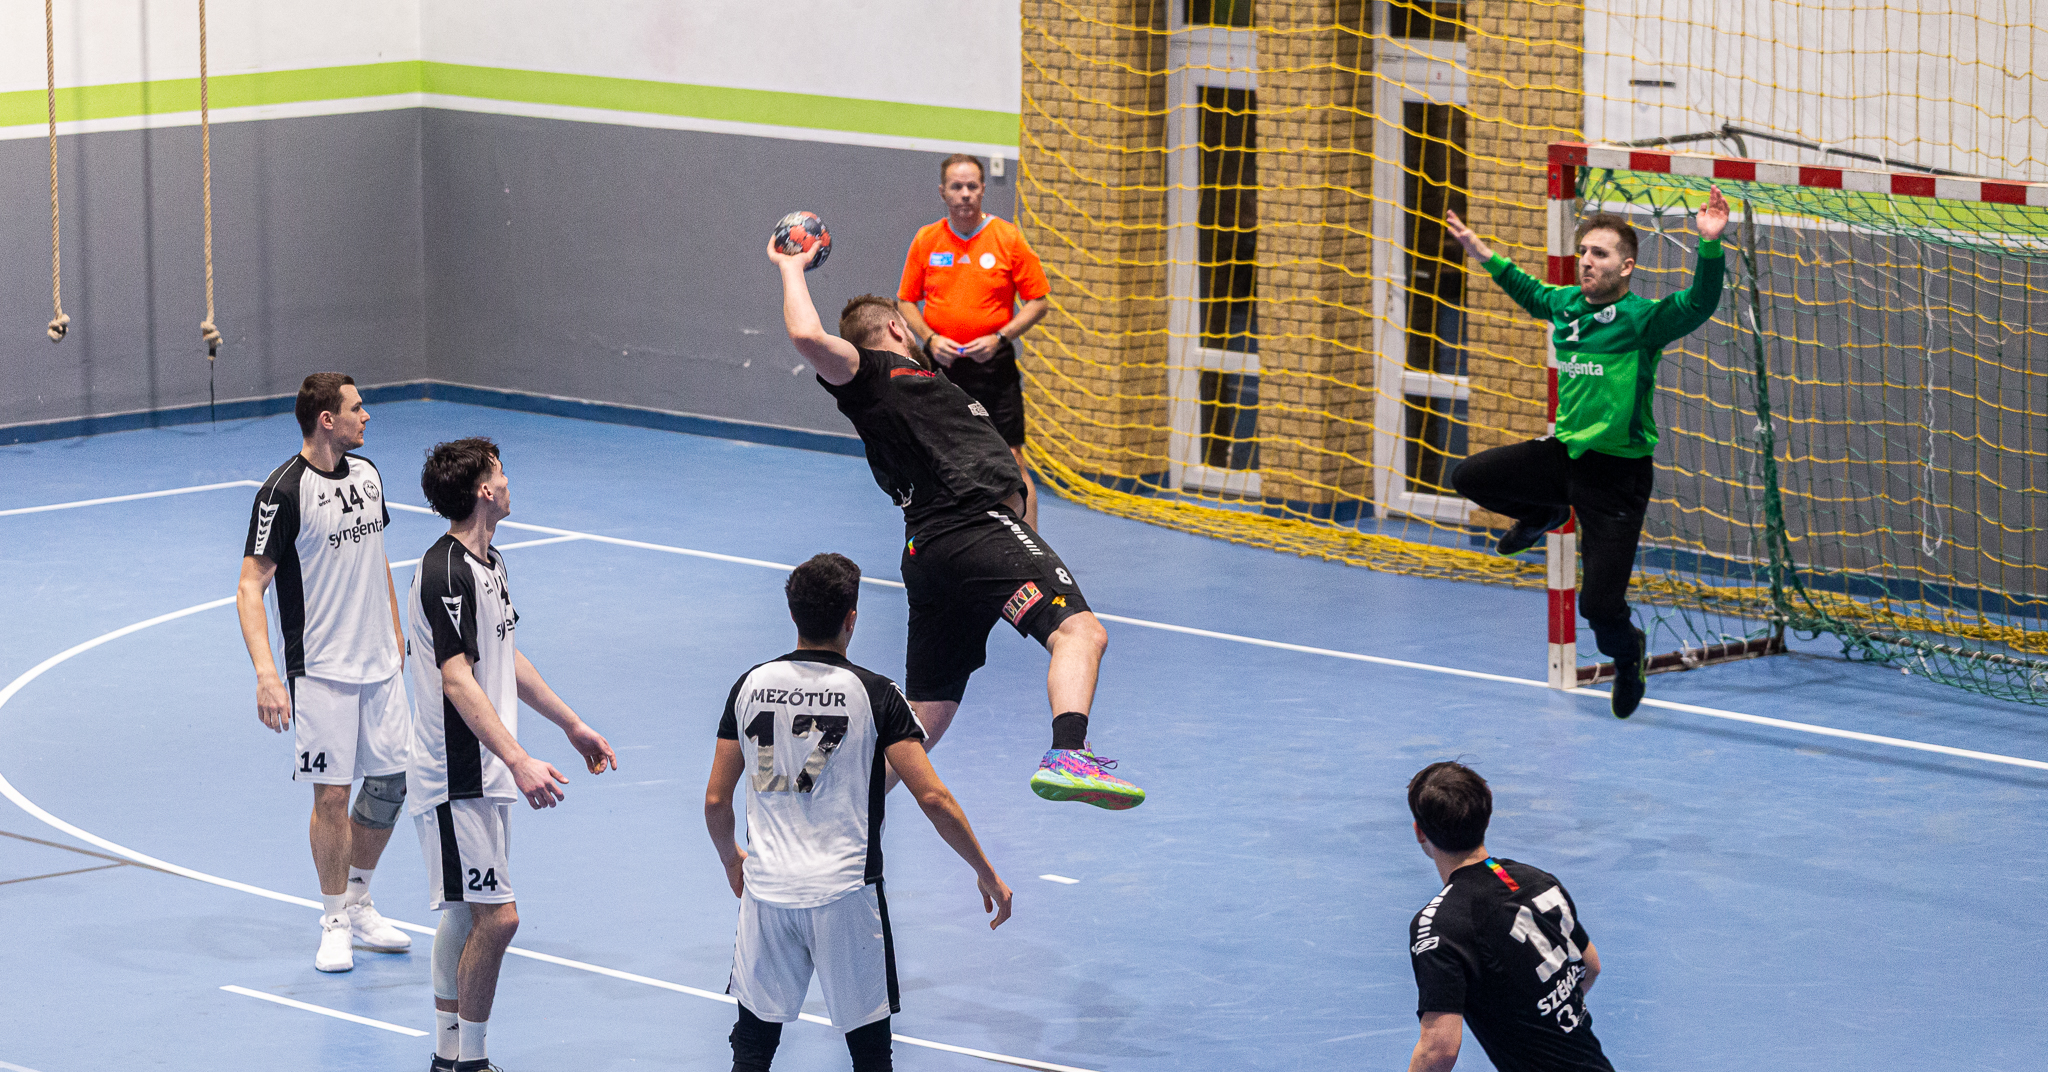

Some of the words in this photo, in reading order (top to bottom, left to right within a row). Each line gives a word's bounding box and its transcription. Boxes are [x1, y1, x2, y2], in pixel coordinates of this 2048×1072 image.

[335, 484, 364, 514] 14
[1055, 567, 1073, 585] 8
[751, 688, 846, 707] MEZŐTÚR
[300, 751, 328, 773] 14
[745, 711, 849, 794] 17
[468, 867, 498, 892] 24
[1509, 885, 1582, 983] 17
